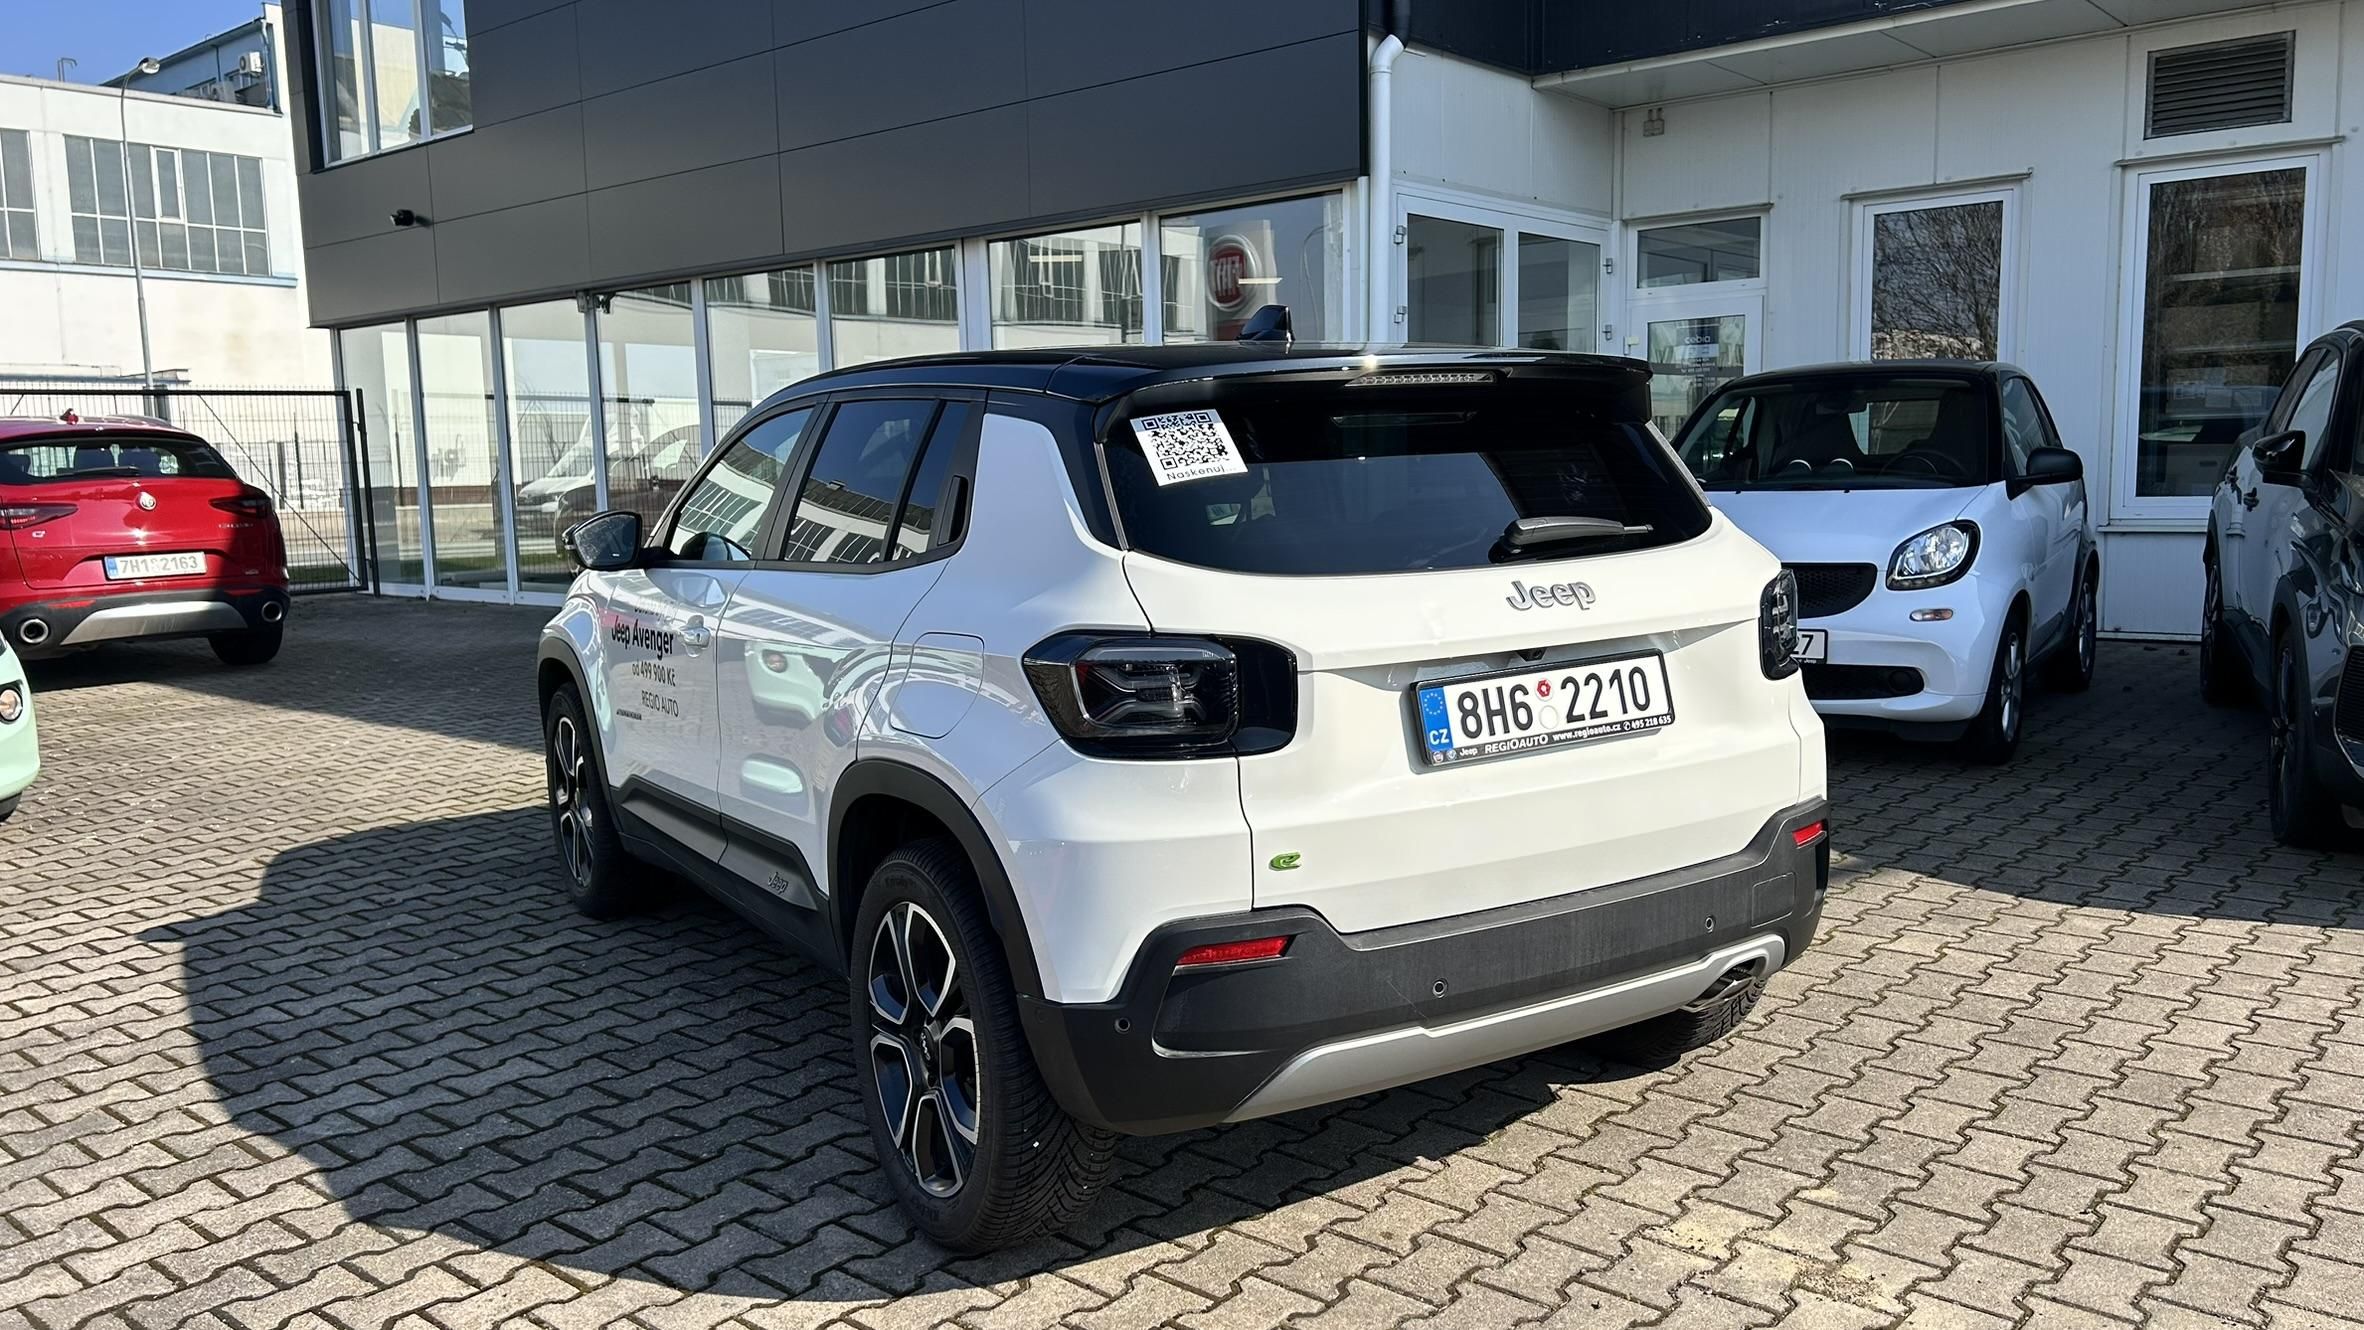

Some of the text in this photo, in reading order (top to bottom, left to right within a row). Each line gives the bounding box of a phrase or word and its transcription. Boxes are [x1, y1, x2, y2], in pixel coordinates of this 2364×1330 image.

[120, 558, 149, 574] 7H1
[160, 556, 198, 571] 2163
[1505, 580, 1596, 611] Jeep
[612, 615, 674, 661] Jeep Avenger
[632, 659, 676, 687] od 499 900 Kč
[641, 689, 660, 712] REGIO
[661, 696, 679, 718] AUTO
[1457, 666, 1651, 739] 8H6 2210
[1429, 728, 1449, 746] CZ
[1459, 714, 1672, 758] Jeep REGIOAUTO www.regioauto.cz 495 218 635
[767, 871, 789, 895] Jeep
